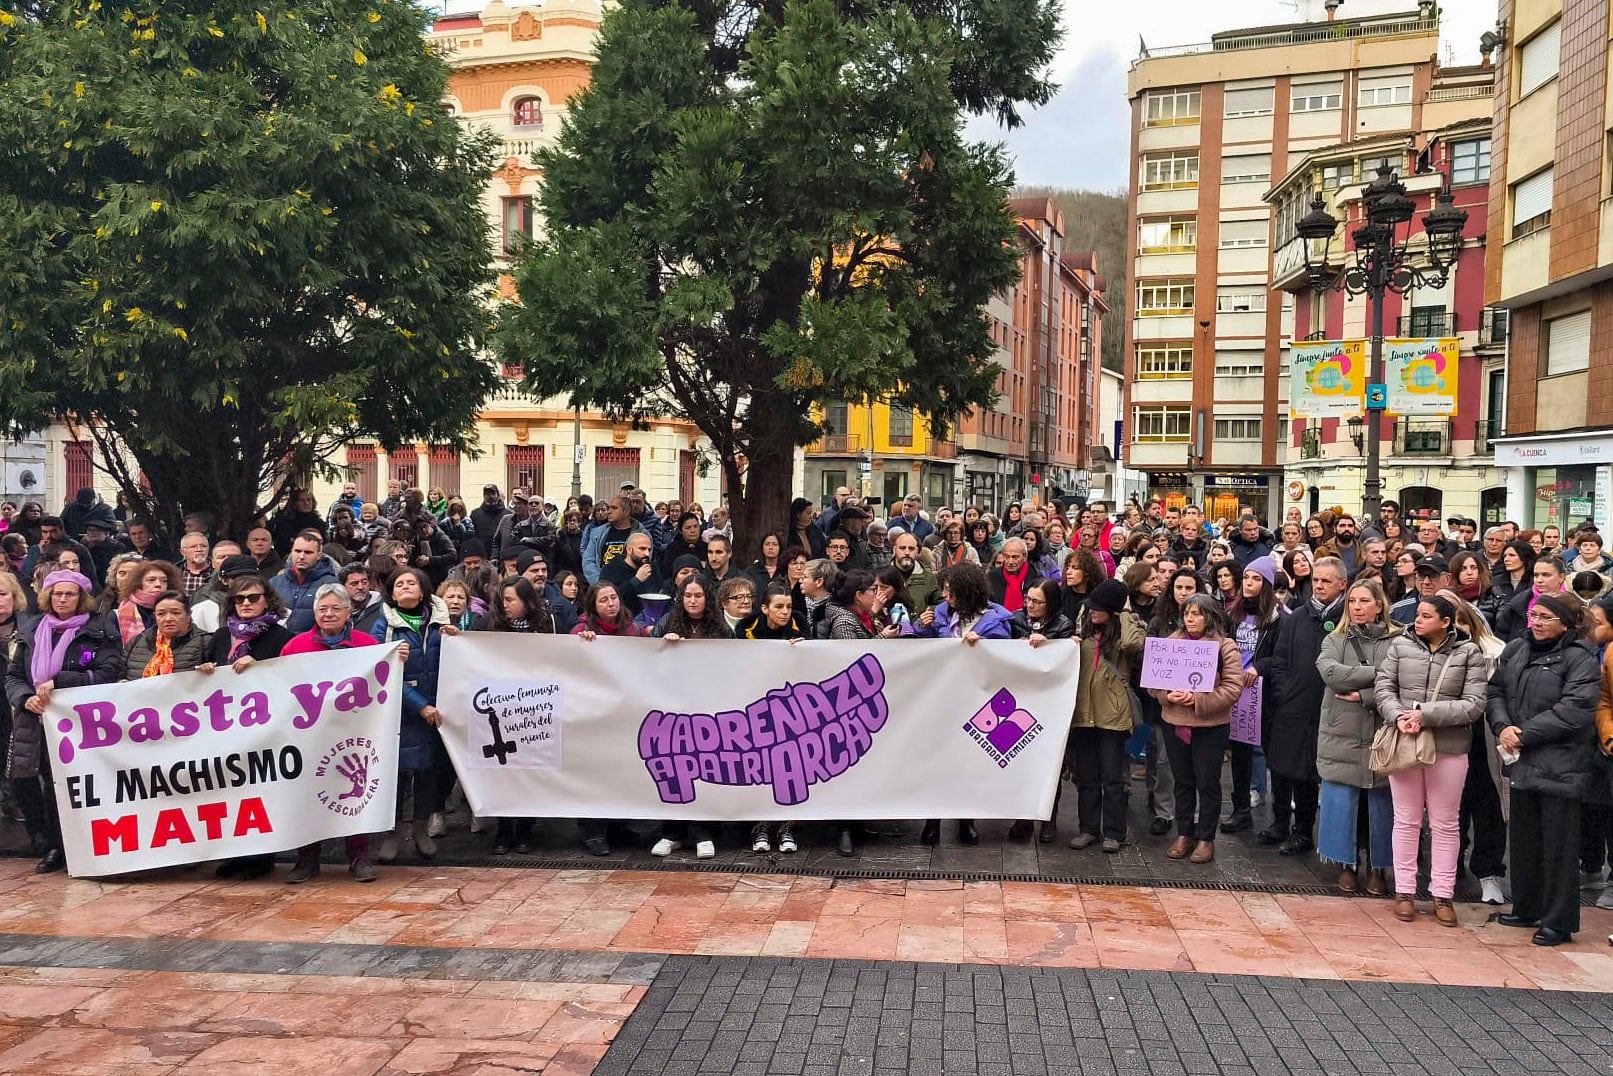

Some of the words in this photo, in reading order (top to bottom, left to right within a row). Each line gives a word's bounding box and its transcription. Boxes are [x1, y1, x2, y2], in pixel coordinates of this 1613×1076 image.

[1526, 448, 1547, 457] CUENCA
[1151, 640, 1168, 651] POR
[1172, 643, 1187, 654] LAS
[1194, 646, 1213, 656] QUE
[1152, 656, 1162, 665] YA
[1167, 658, 1178, 666] NO
[1184, 658, 1214, 668] TIENEN
[1152, 669, 1173, 679] VOZ
[517, 684, 559, 701] feminista
[57, 688, 272, 765] ¡Basta
[290, 660, 391, 730] ya!
[502, 707, 512, 717] de
[638, 653, 885, 760] MADREÑAZU
[504, 717, 536, 733] rurales
[537, 713, 552, 726] del
[520, 731, 551, 744] oriente
[968, 728, 1002, 762] BRIGADA
[1004, 723, 1044, 762] FEMINISTA
[315, 737, 372, 777] MUJERES
[370, 747, 380, 765] DE
[66, 774, 101, 809] EL
[115, 745, 304, 804] MACHISMO
[317, 790, 329, 805] LA
[91, 797, 273, 857] MATA
